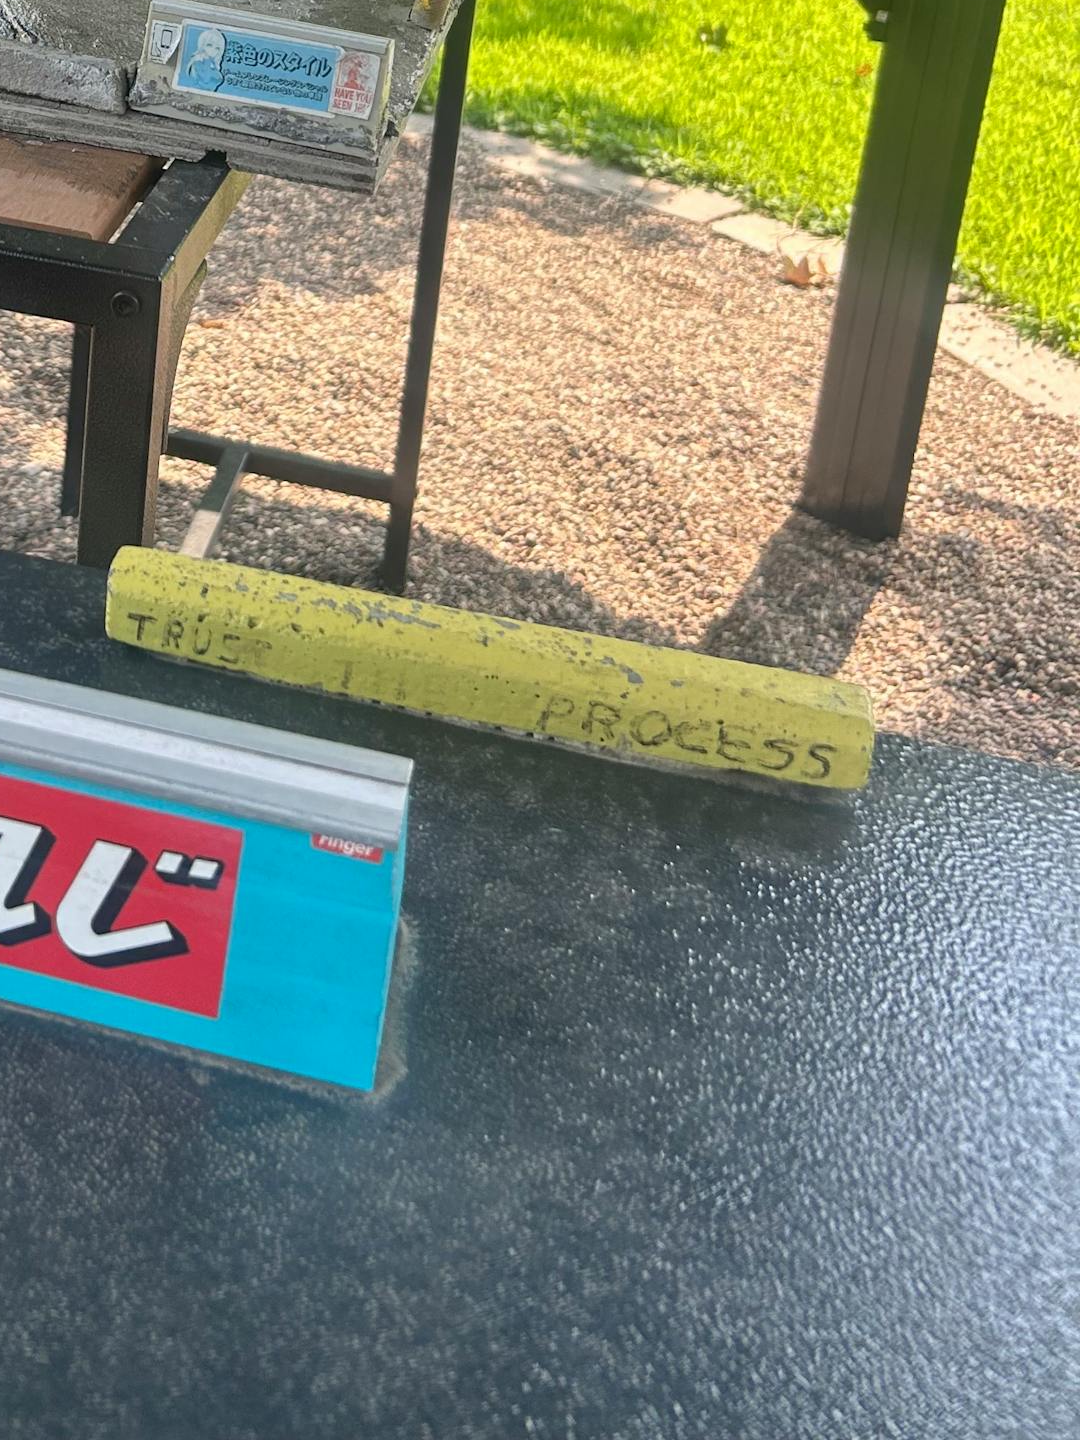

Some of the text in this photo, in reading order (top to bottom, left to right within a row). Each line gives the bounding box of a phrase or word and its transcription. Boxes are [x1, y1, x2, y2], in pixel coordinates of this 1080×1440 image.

[224, 41, 332, 78] 紫色のスタイル
[333, 98, 352, 110] SEEN
[334, 87, 355, 101] HAVE
[536, 695, 837, 779] PROCESS
